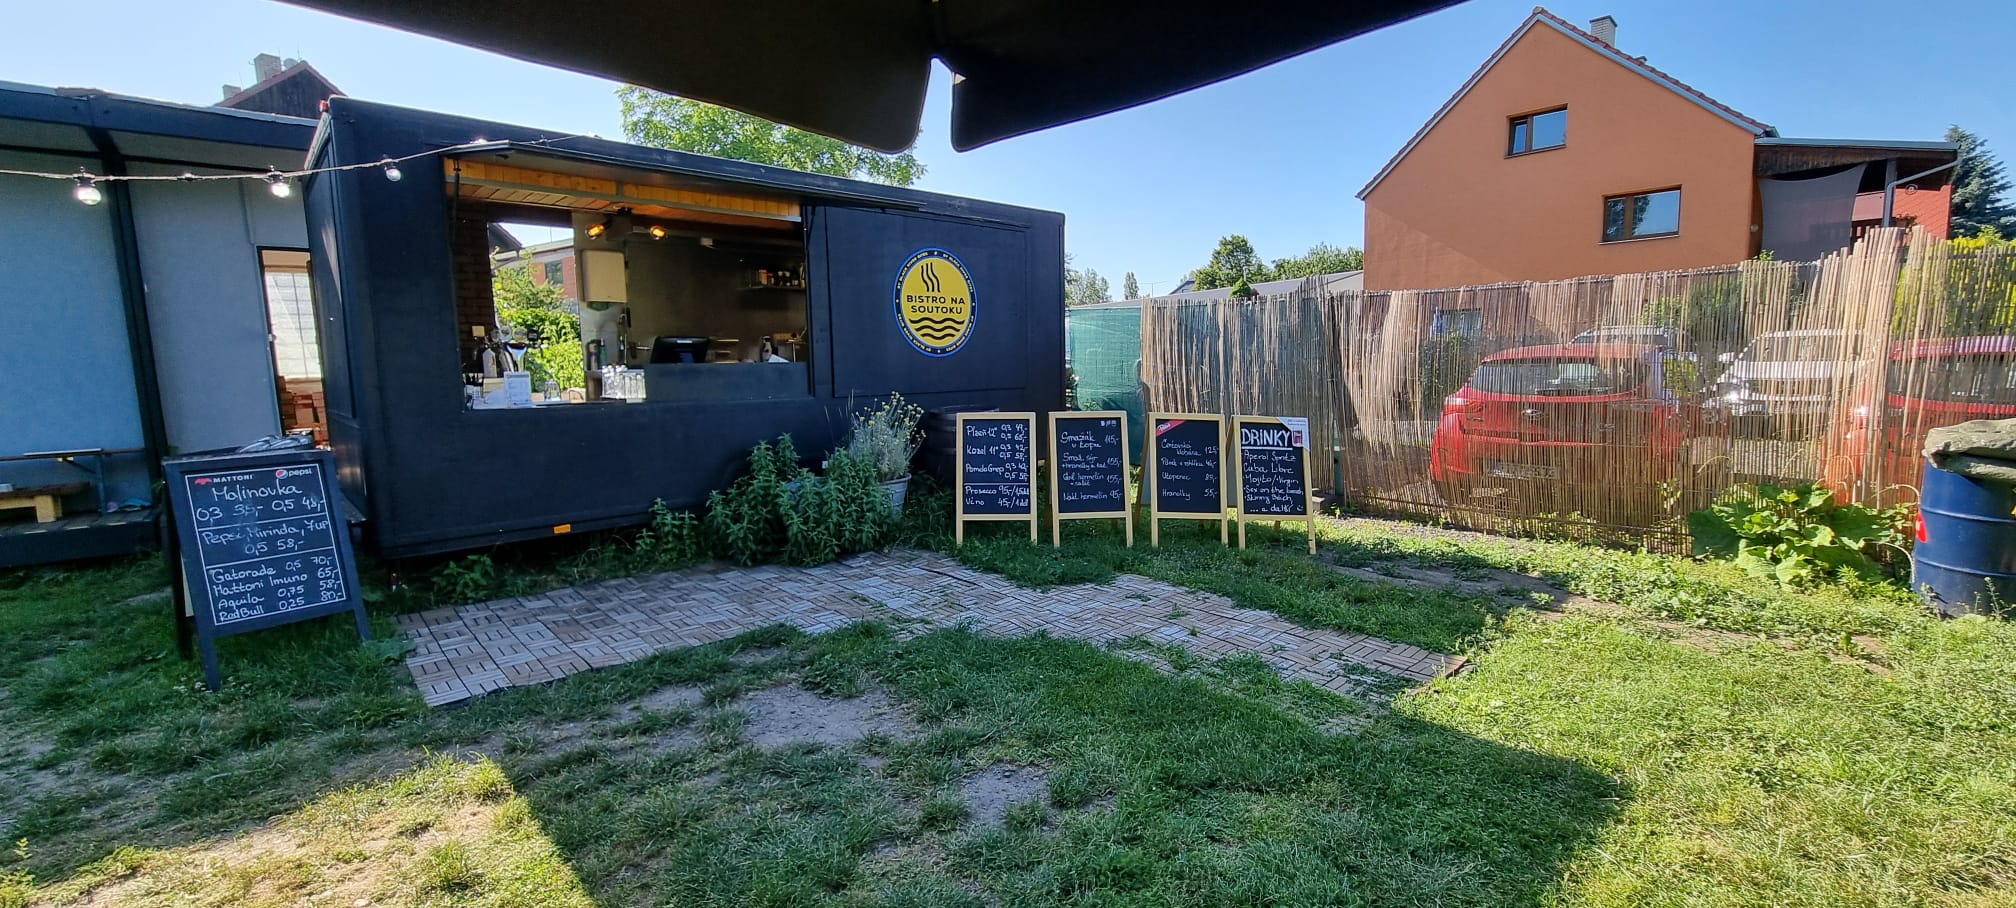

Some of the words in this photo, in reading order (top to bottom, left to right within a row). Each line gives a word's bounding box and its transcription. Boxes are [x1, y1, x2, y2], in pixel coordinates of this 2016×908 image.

[906, 294, 946, 304] BISTRO
[911, 305, 962, 314] SOUTOKU
[1241, 428, 1290, 447] DRINKY
[966, 444, 986, 455] Kozel
[288, 468, 312, 478] pepsi
[1244, 462, 1268, 473] Cuba
[212, 479, 302, 500] Malinovka
[965, 486, 997, 494] Prosecco
[196, 506, 223, 525] 0,3
[272, 499, 296, 512] 0,5
[244, 541, 268, 556] 0,5
[212, 564, 276, 583] Gatorade
[285, 560, 302, 572] 0,5
[213, 579, 264, 597] Mattoni
[270, 573, 308, 587] Imuno
[218, 594, 264, 610] Aquila
[278, 585, 304, 598] 0,75
[279, 597, 304, 610] 0,25
